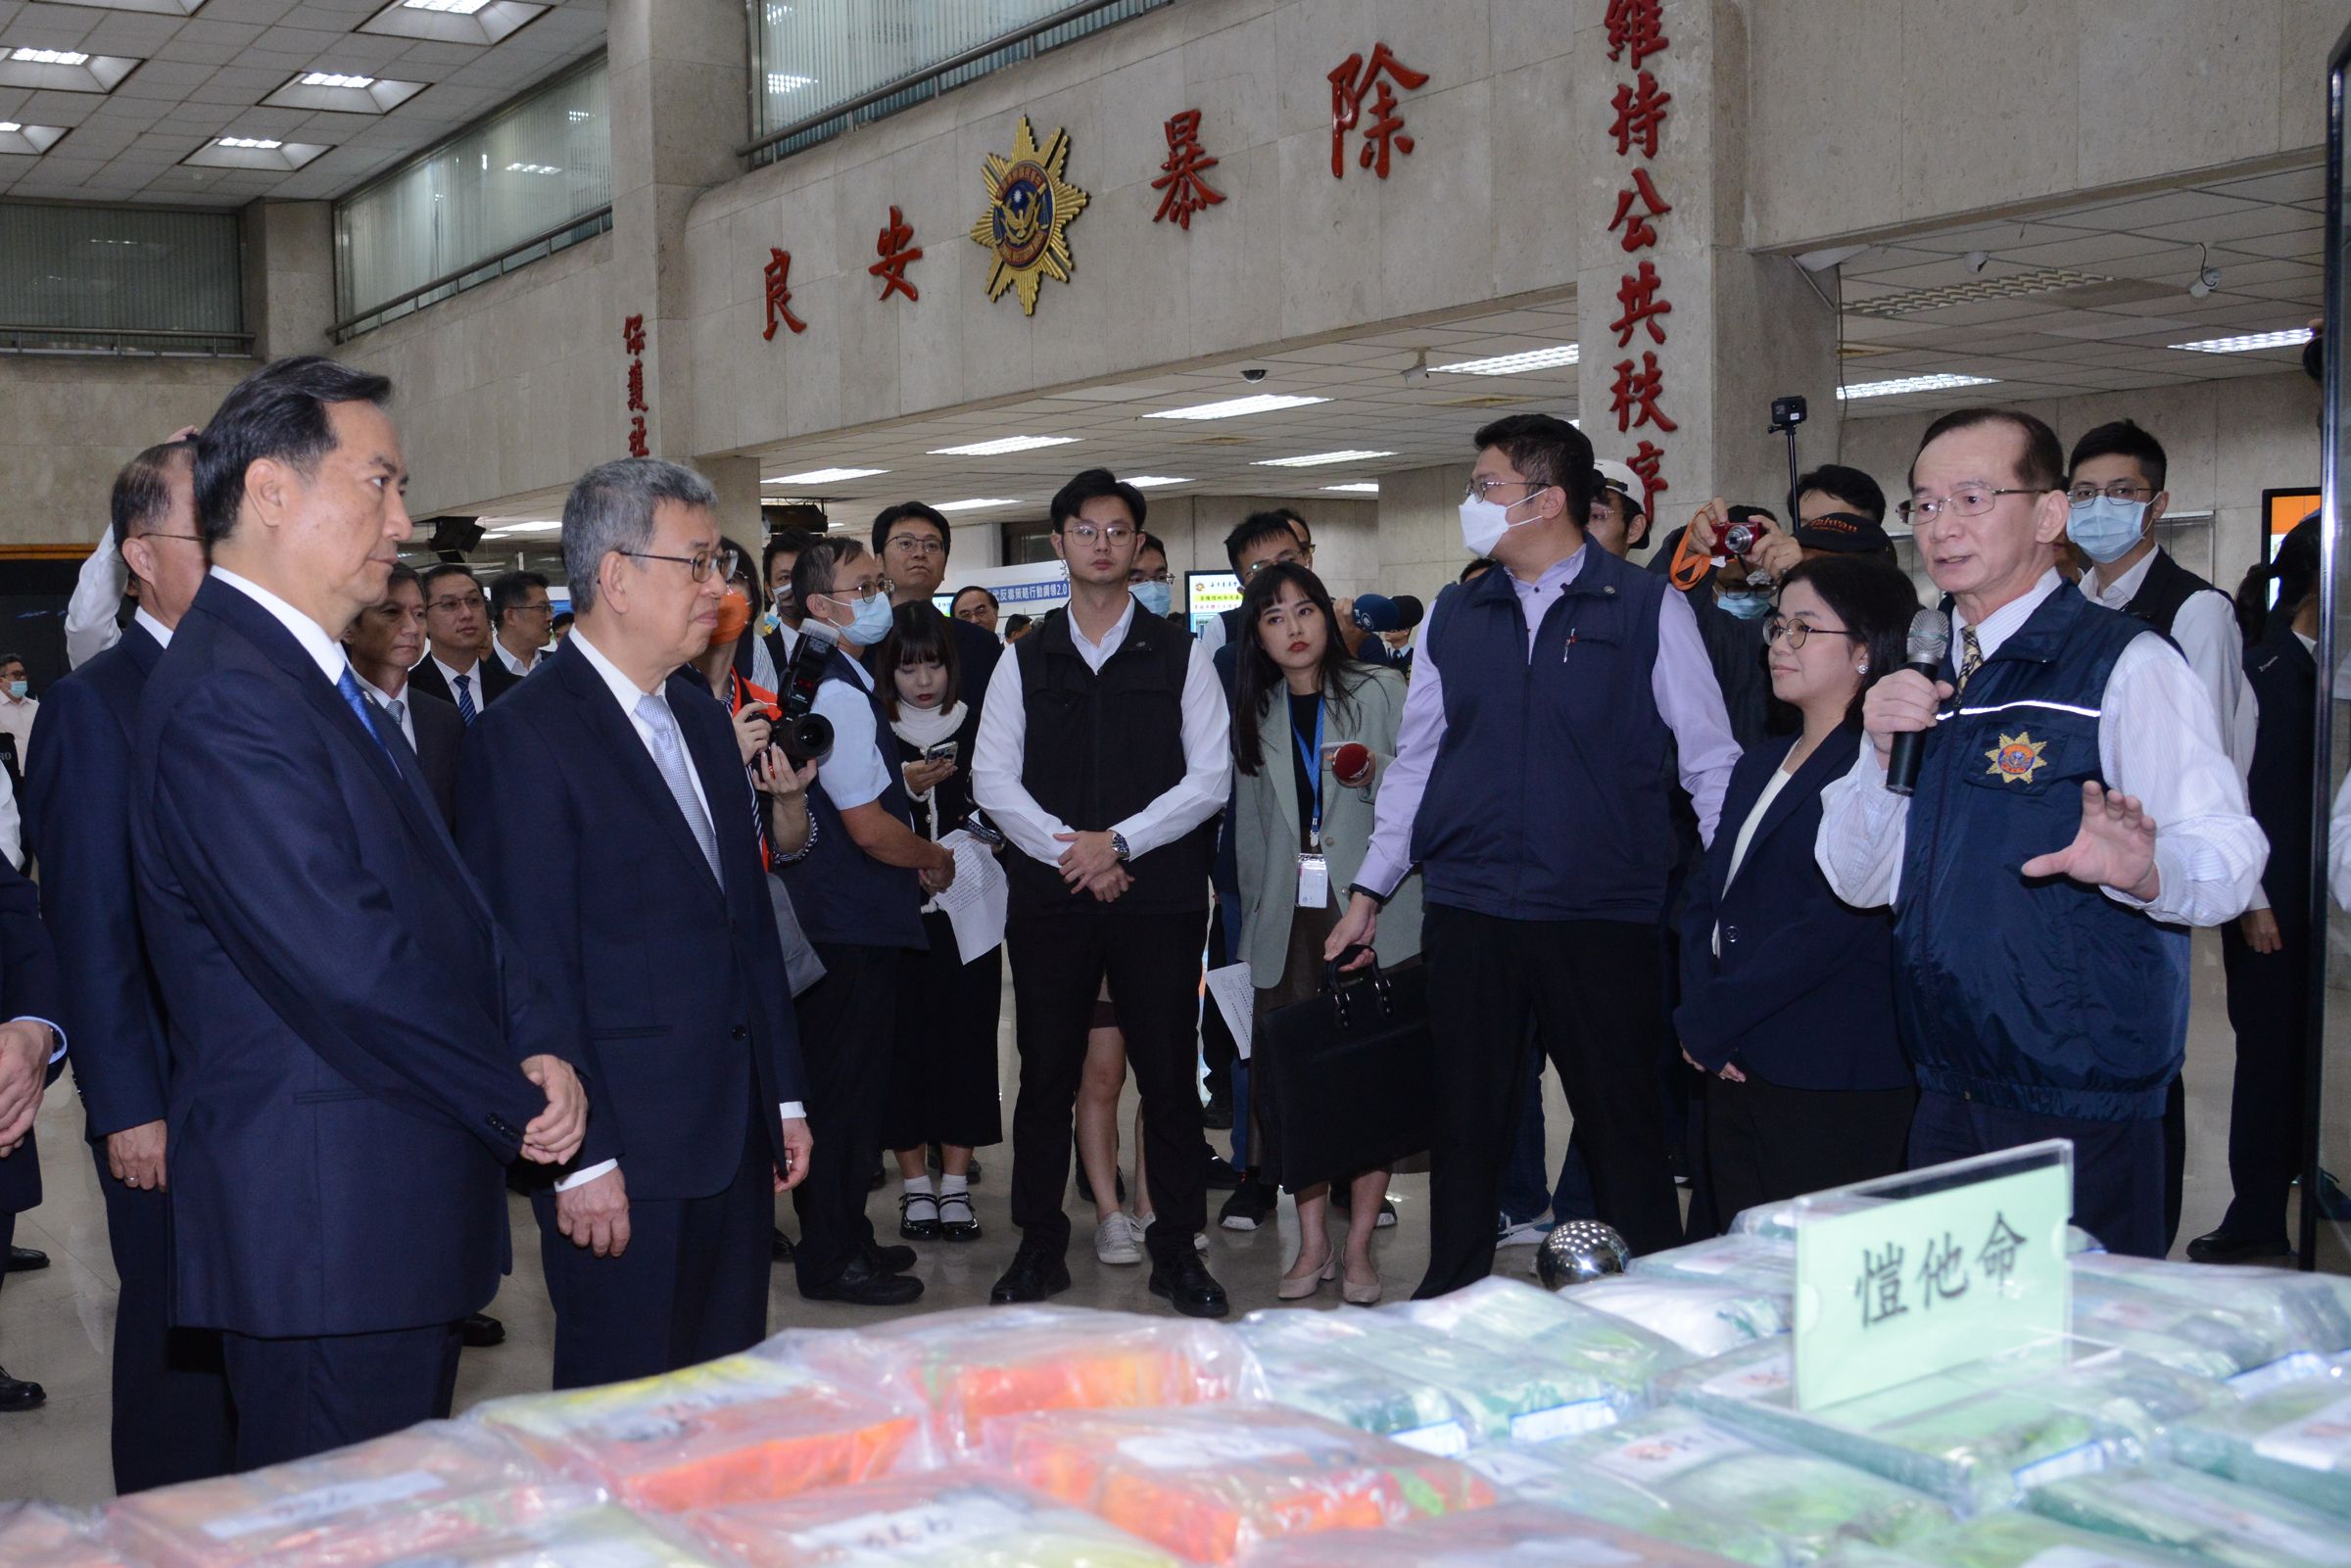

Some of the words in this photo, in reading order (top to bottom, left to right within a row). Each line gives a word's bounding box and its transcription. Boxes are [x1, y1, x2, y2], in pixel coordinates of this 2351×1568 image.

[1605, 0, 1676, 525] 維持公共秩序
[1854, 1211, 2028, 1328] 愷他命
